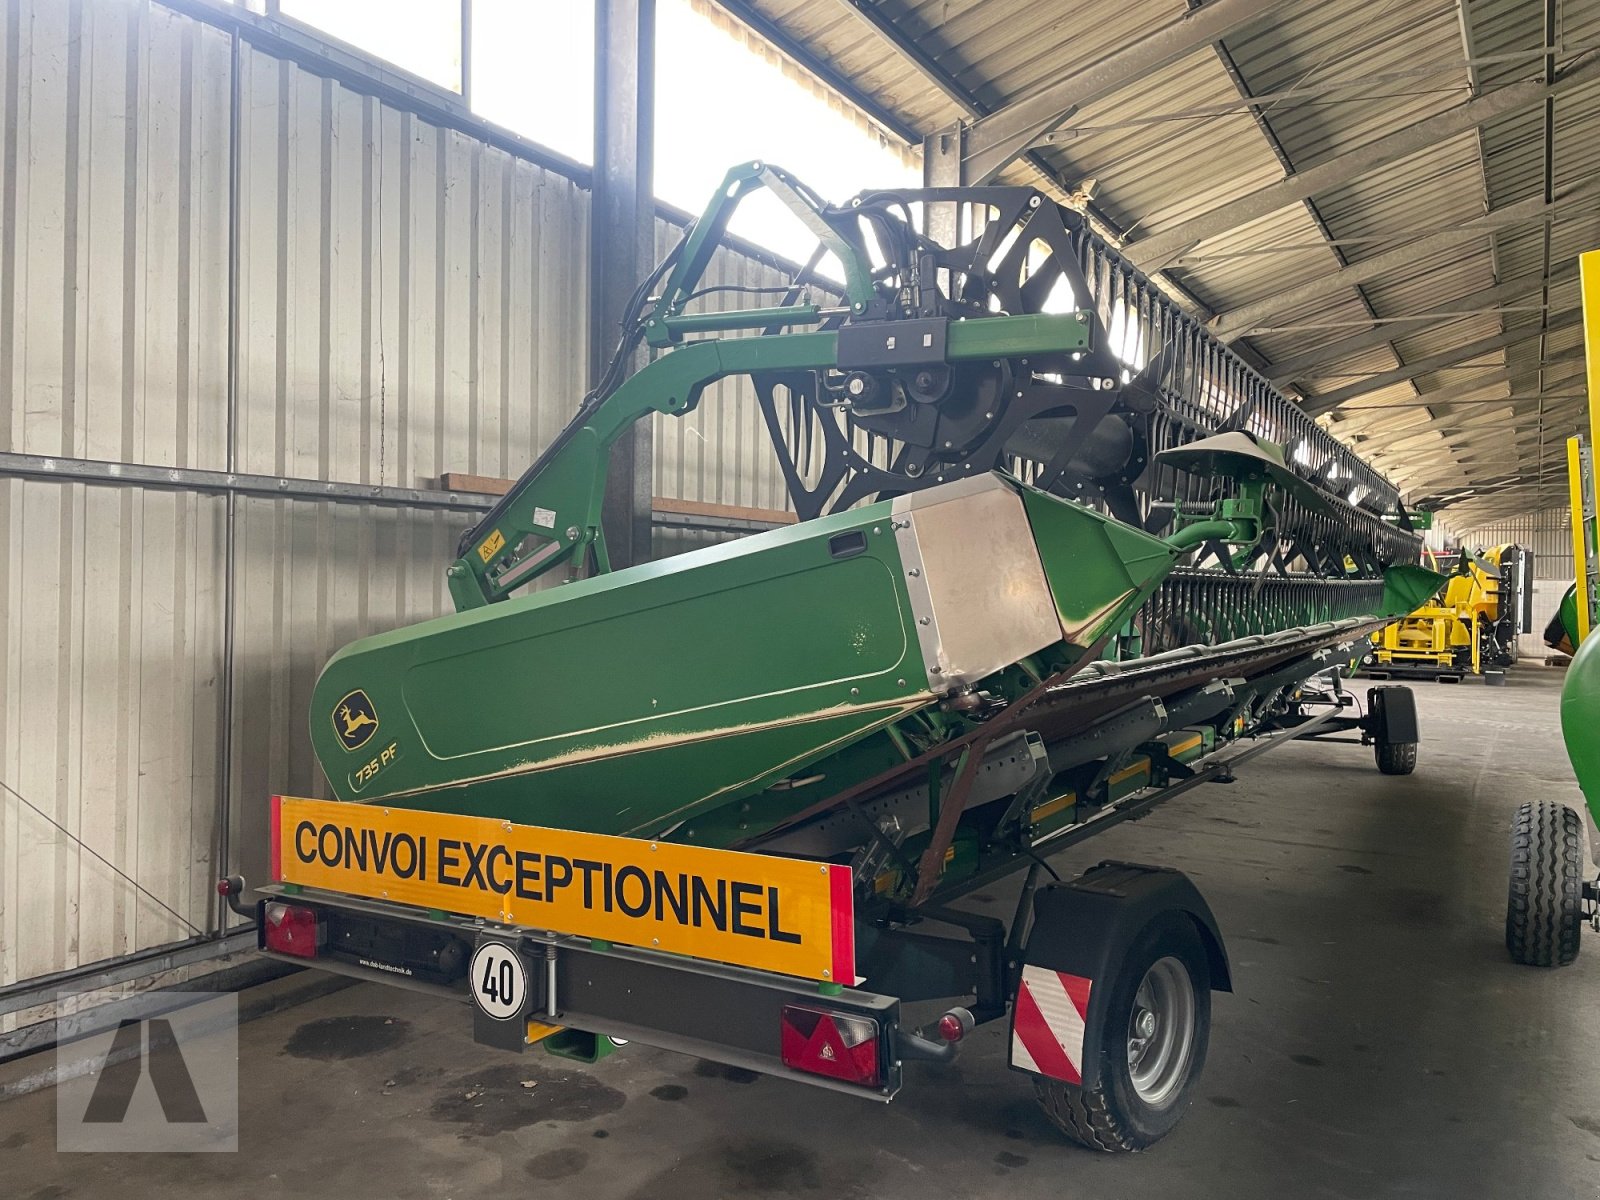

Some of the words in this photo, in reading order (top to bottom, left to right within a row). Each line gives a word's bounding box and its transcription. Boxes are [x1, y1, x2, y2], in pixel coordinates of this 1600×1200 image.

[355, 758, 379, 785] 735
[380, 742, 397, 766] PF
[295, 821, 426, 881] CONVOI
[438, 839, 802, 944] EXCEPTIONNEL
[482, 957, 514, 1007] 40
